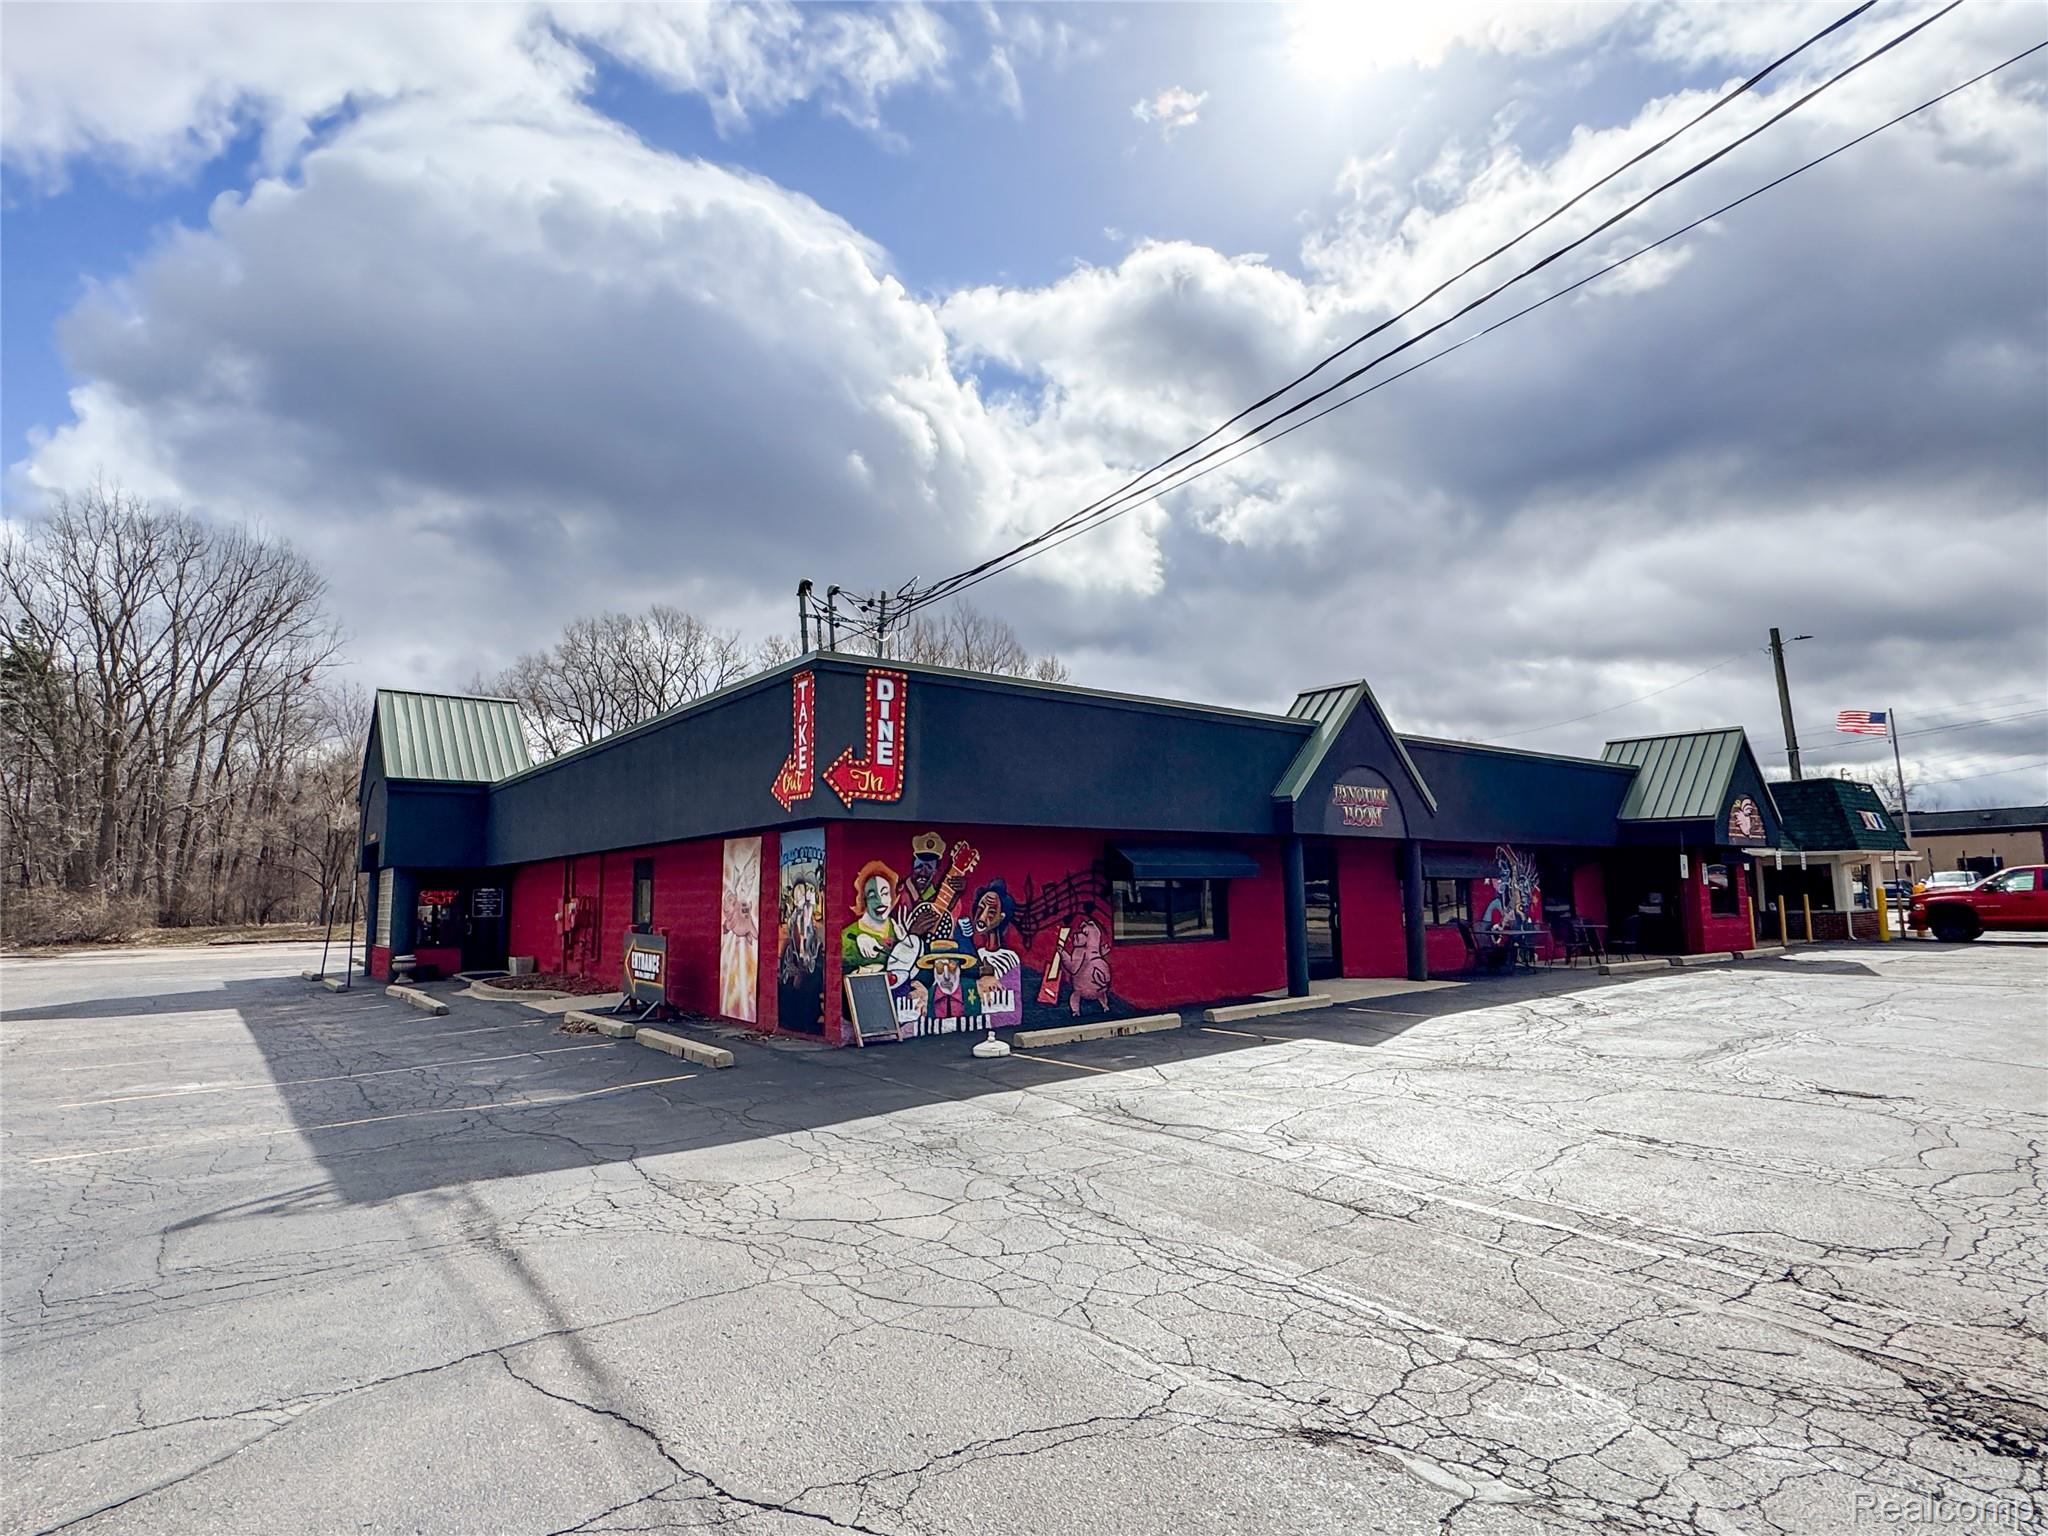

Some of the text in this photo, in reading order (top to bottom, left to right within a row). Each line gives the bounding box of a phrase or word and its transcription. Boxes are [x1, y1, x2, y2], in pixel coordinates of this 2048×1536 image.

[797, 680, 809, 770] TAKE
[876, 678, 895, 766] DINE
[782, 770, 806, 794] Out
[849, 768, 886, 792] In
[1342, 805, 1384, 828] ROOM
[423, 896, 454, 905] OUT
[631, 951, 661, 974] ENTRANCE
